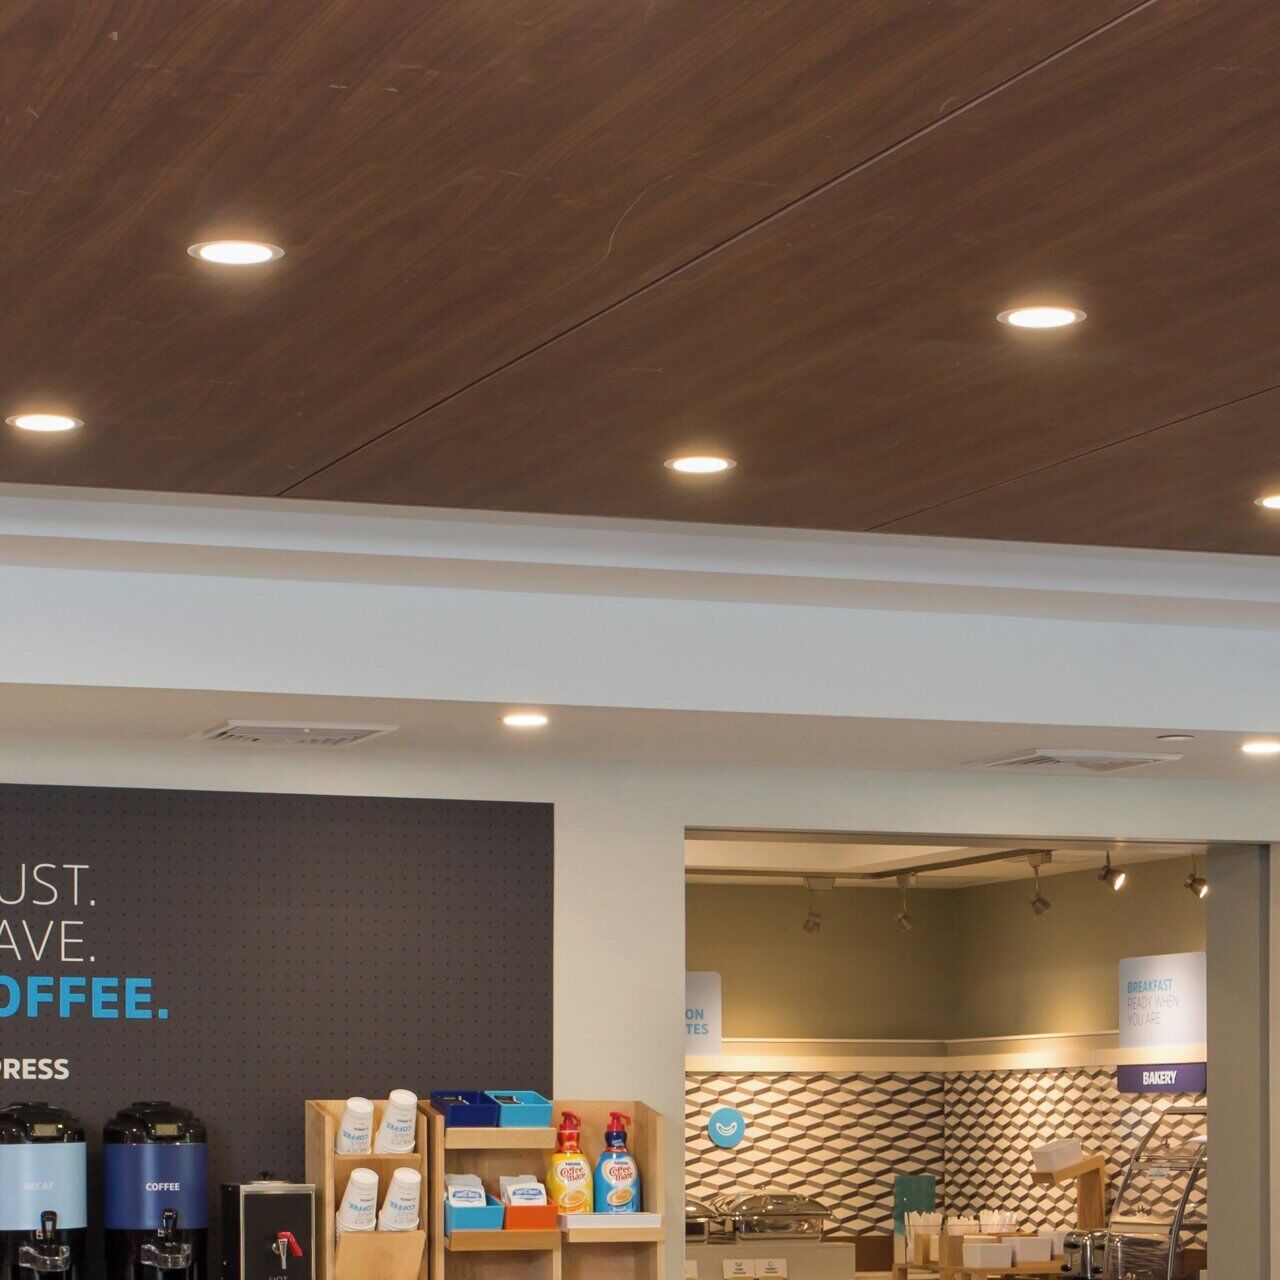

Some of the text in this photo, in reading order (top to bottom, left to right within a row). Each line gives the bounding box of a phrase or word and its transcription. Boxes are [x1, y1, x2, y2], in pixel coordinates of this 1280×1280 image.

[1127, 978, 1173, 993] BREAKFAST
[1142, 1070, 1177, 1086] BAKERY
[145, 1182, 180, 1192] COFFEE
